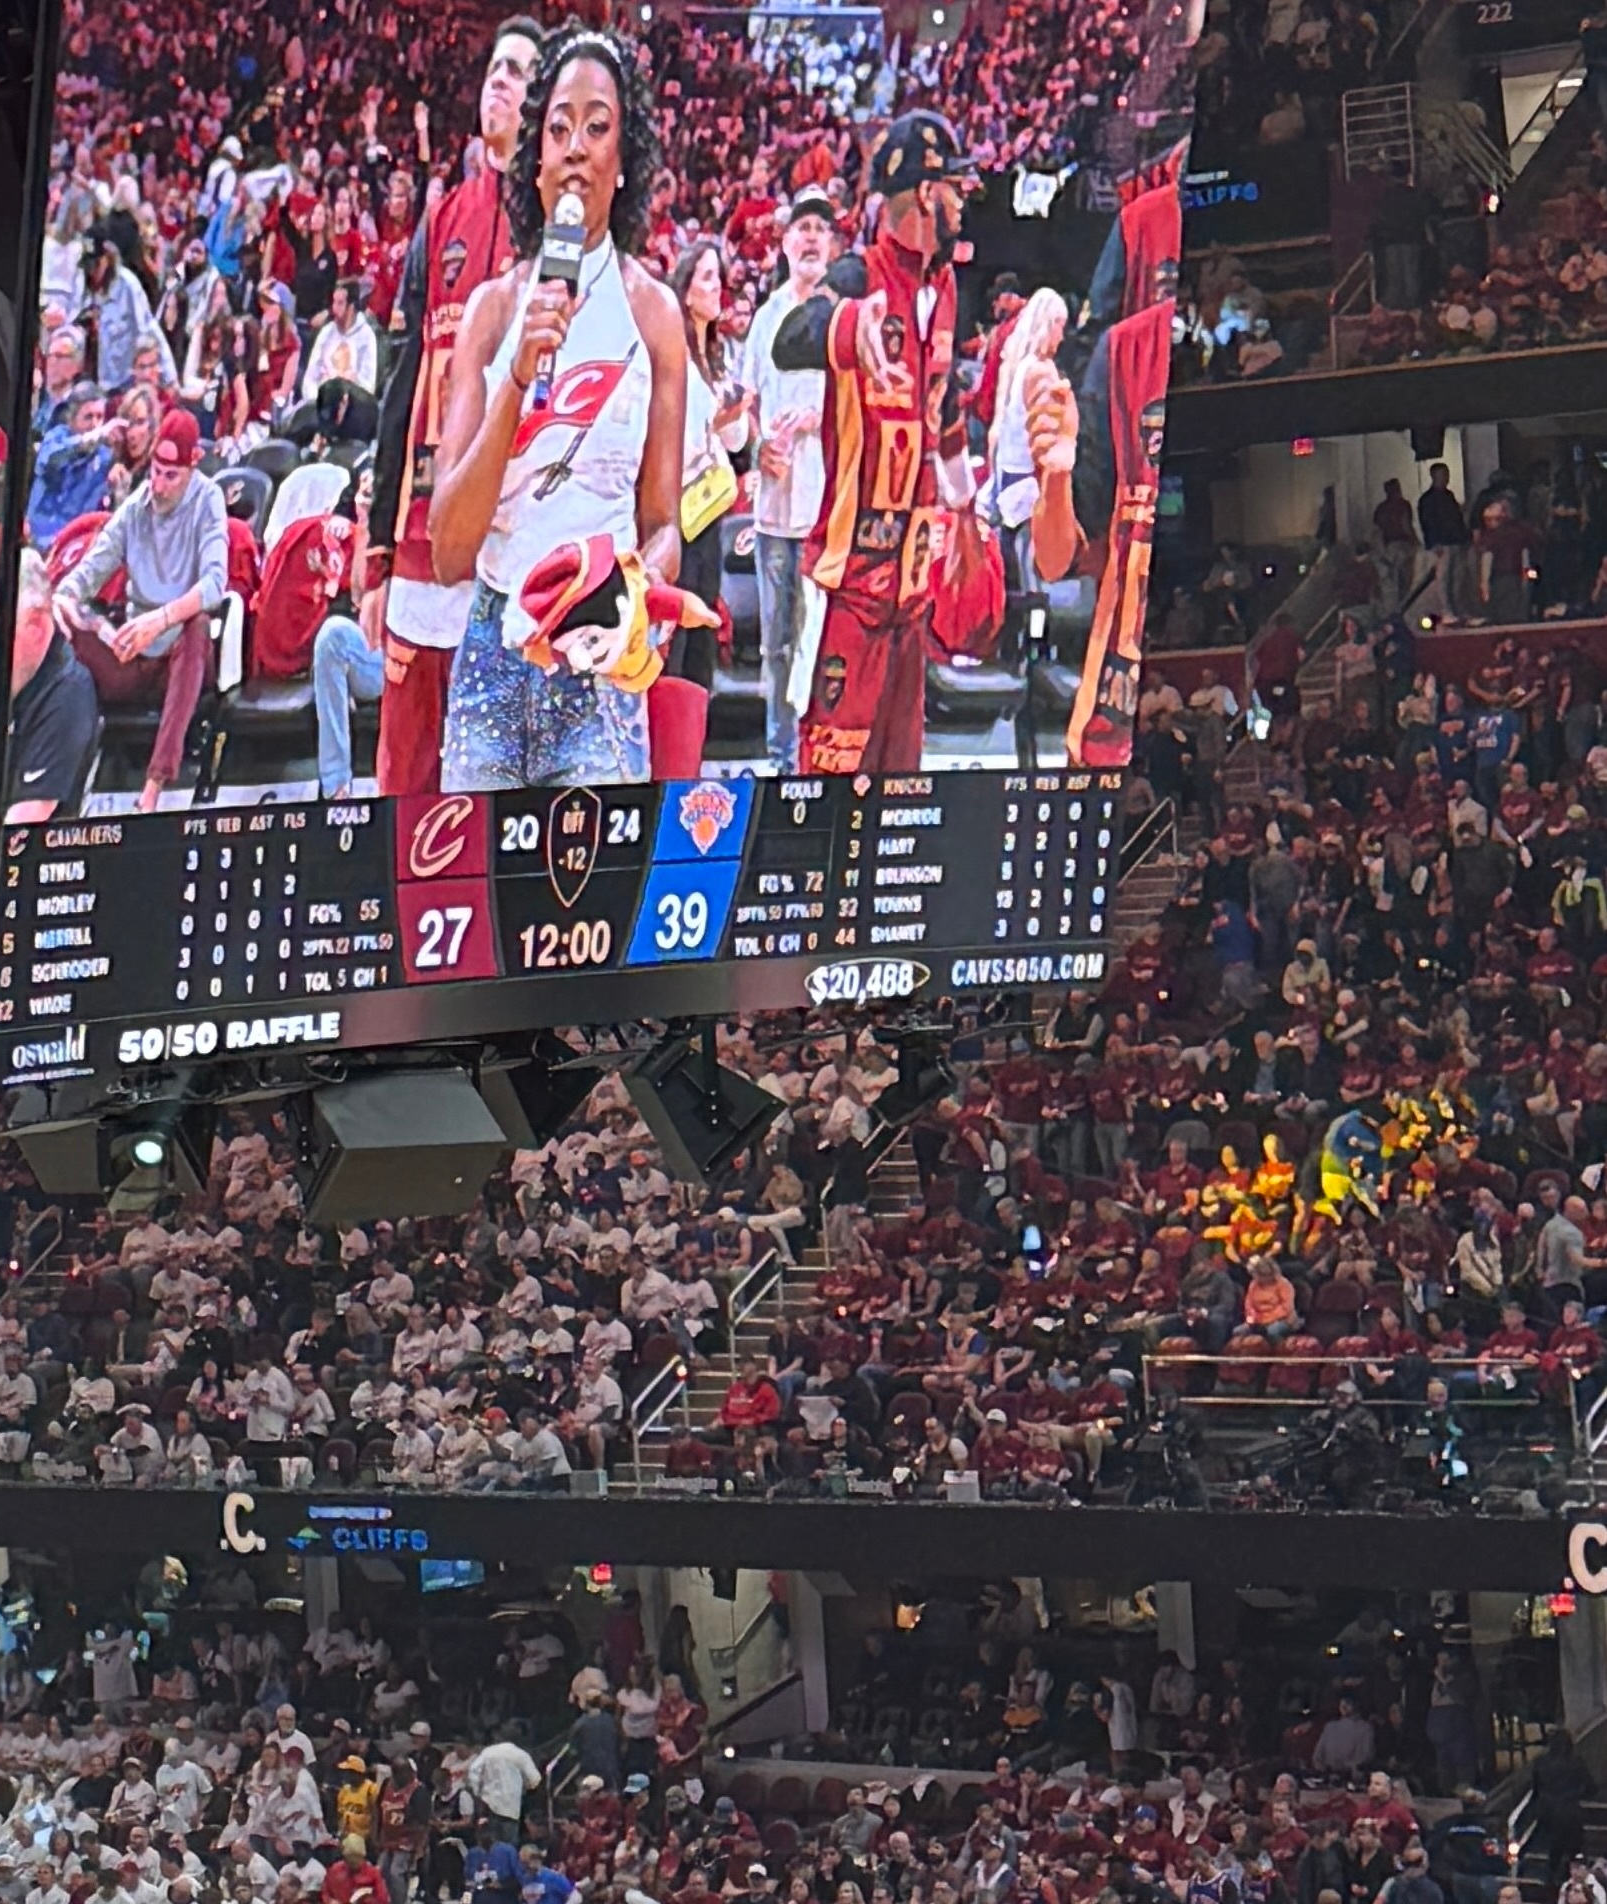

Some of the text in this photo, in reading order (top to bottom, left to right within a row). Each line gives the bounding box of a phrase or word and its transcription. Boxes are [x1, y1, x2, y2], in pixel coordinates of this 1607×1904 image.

[1476, 0, 1514, 27] 222
[883, 777, 933, 796] KNICKS
[793, 800, 807, 824] 0
[851, 810, 863, 830] 2
[45, 824, 122, 847] CAVALIERS
[340, 826, 353, 852] 0
[500, 814, 540, 851] 2Q
[606, 808, 641, 845] 24
[558, 847, 588, 872] -12
[848, 837, 916, 859] 3 HART
[7, 844, 297, 887] 2 STRUS 1 1
[845, 865, 943, 887] 11 BRUNSON
[804, 871, 825, 893] 72
[5, 893, 96, 918] 4 MOBLEY
[838, 897, 859, 918] 32
[655, 891, 709, 950] 39
[2, 932, 14, 954] 5
[414, 906, 474, 968] 27
[520, 919, 612, 969] 12:00
[835, 927, 856, 945] 44
[951, 952, 1105, 987] CAVS5050.COM
[29, 994, 72, 1016] WADE
[226, 1012, 341, 1049] RAFFLE
[12, 1023, 87, 1069] oswald
[331, 1527, 430, 1552] CLIFFS
